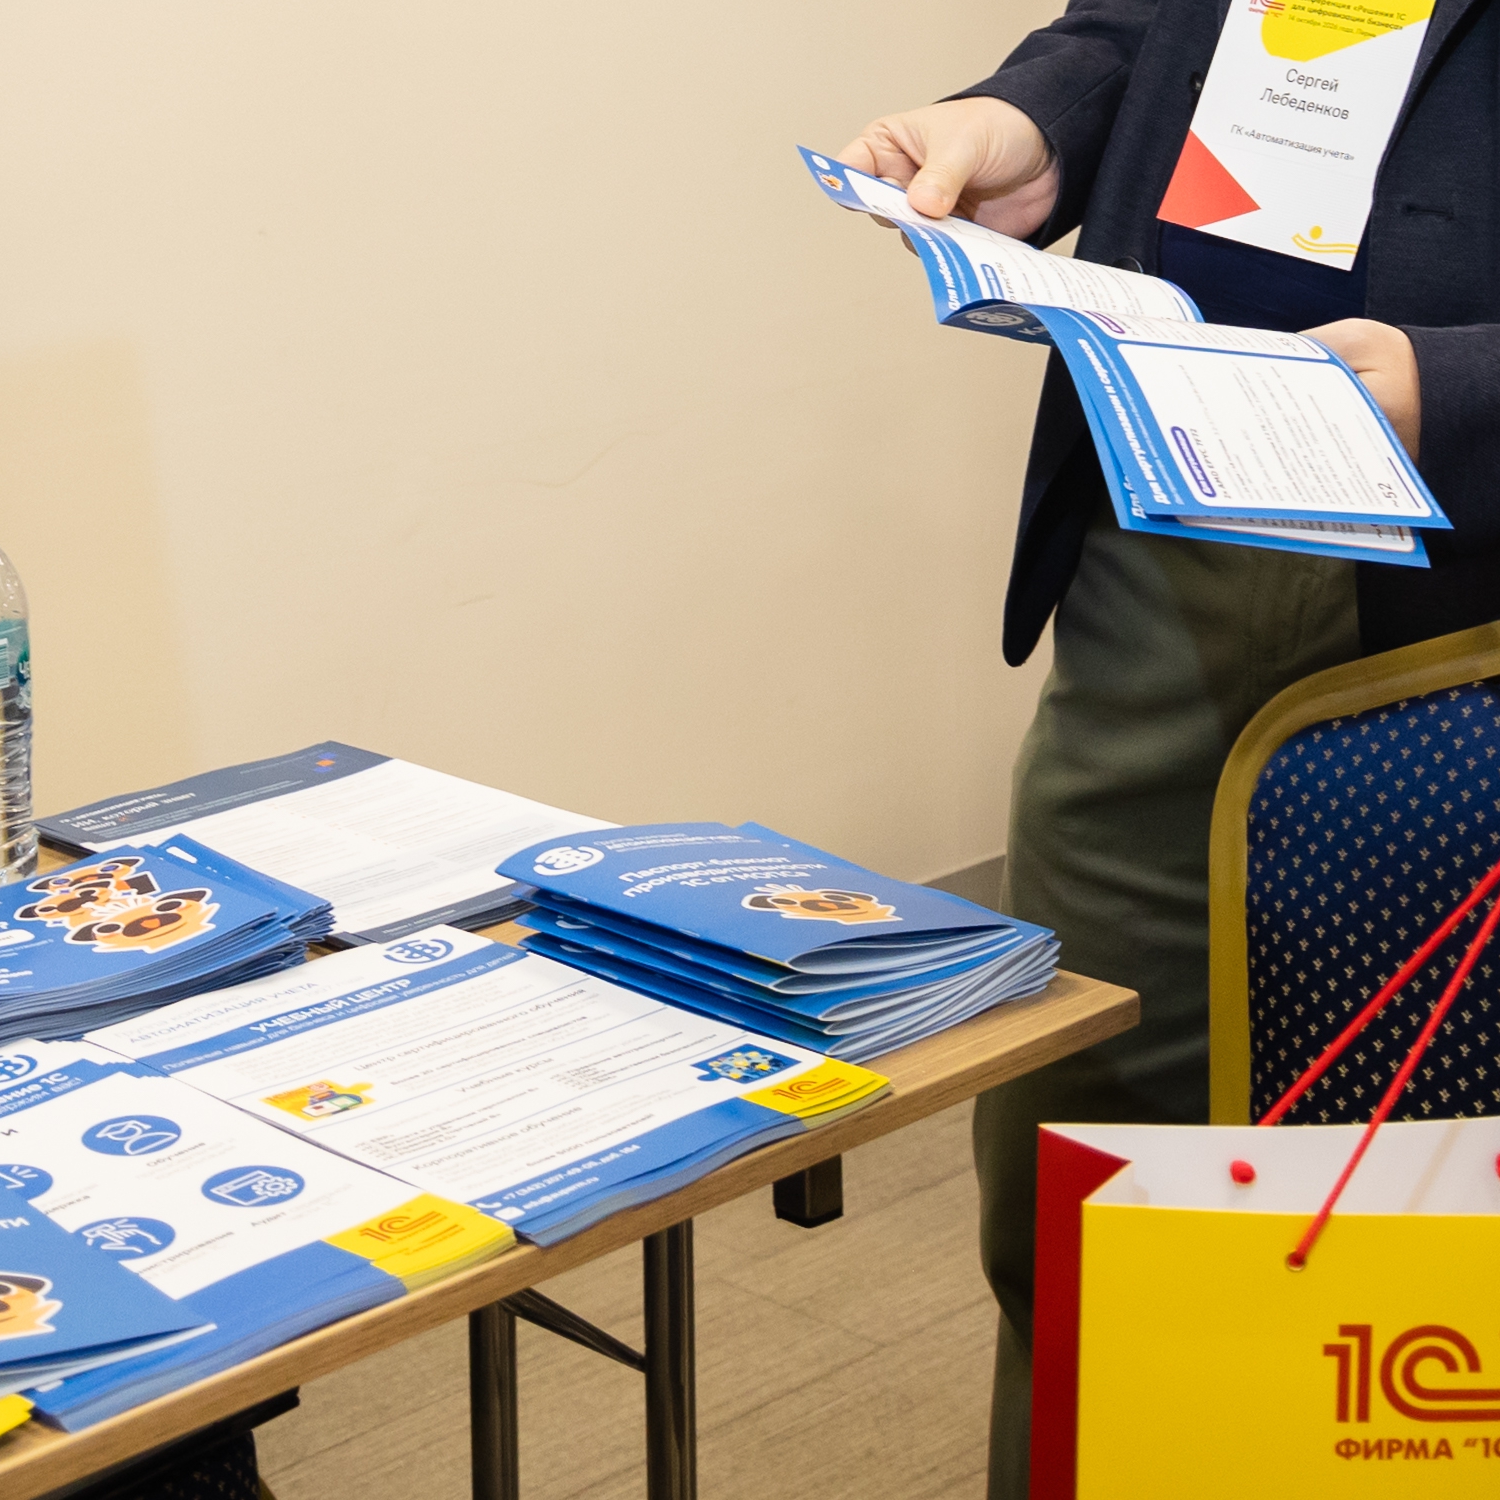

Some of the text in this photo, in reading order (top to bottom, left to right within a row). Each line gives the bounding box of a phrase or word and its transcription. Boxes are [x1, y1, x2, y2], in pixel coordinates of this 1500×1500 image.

[1291, 4, 1306, 13] для
[1307, 7, 1365, 24] цифровизации
[1395, 12, 1407, 21] 1С
[1286, 68, 1339, 92] Сергей
[1260, 87, 1350, 120] Лебеденков
[1230, 124, 1355, 161] ГК «Автоматизация учета»
[1108, 394, 1157, 481] виртуализации
[1149, 480, 1172, 505] Для
[618, 857, 791, 883] Паспорт-блокнот
[623, 863, 828, 898] производительности
[680, 877, 710, 888] 1С
[711, 874, 734, 884] от
[130, 982, 319, 1044] АВТОМАТИЗАЦИЯ УЧЕТА
[250, 978, 412, 1034] УЧЕБНЫЙ ЦЕНТР
[39, 1072, 69, 1086] 1С
[771, 1077, 852, 1102] 1С
[359, 1210, 448, 1242] 1С
[1334, 1437, 1454, 1461] ФИРМА
